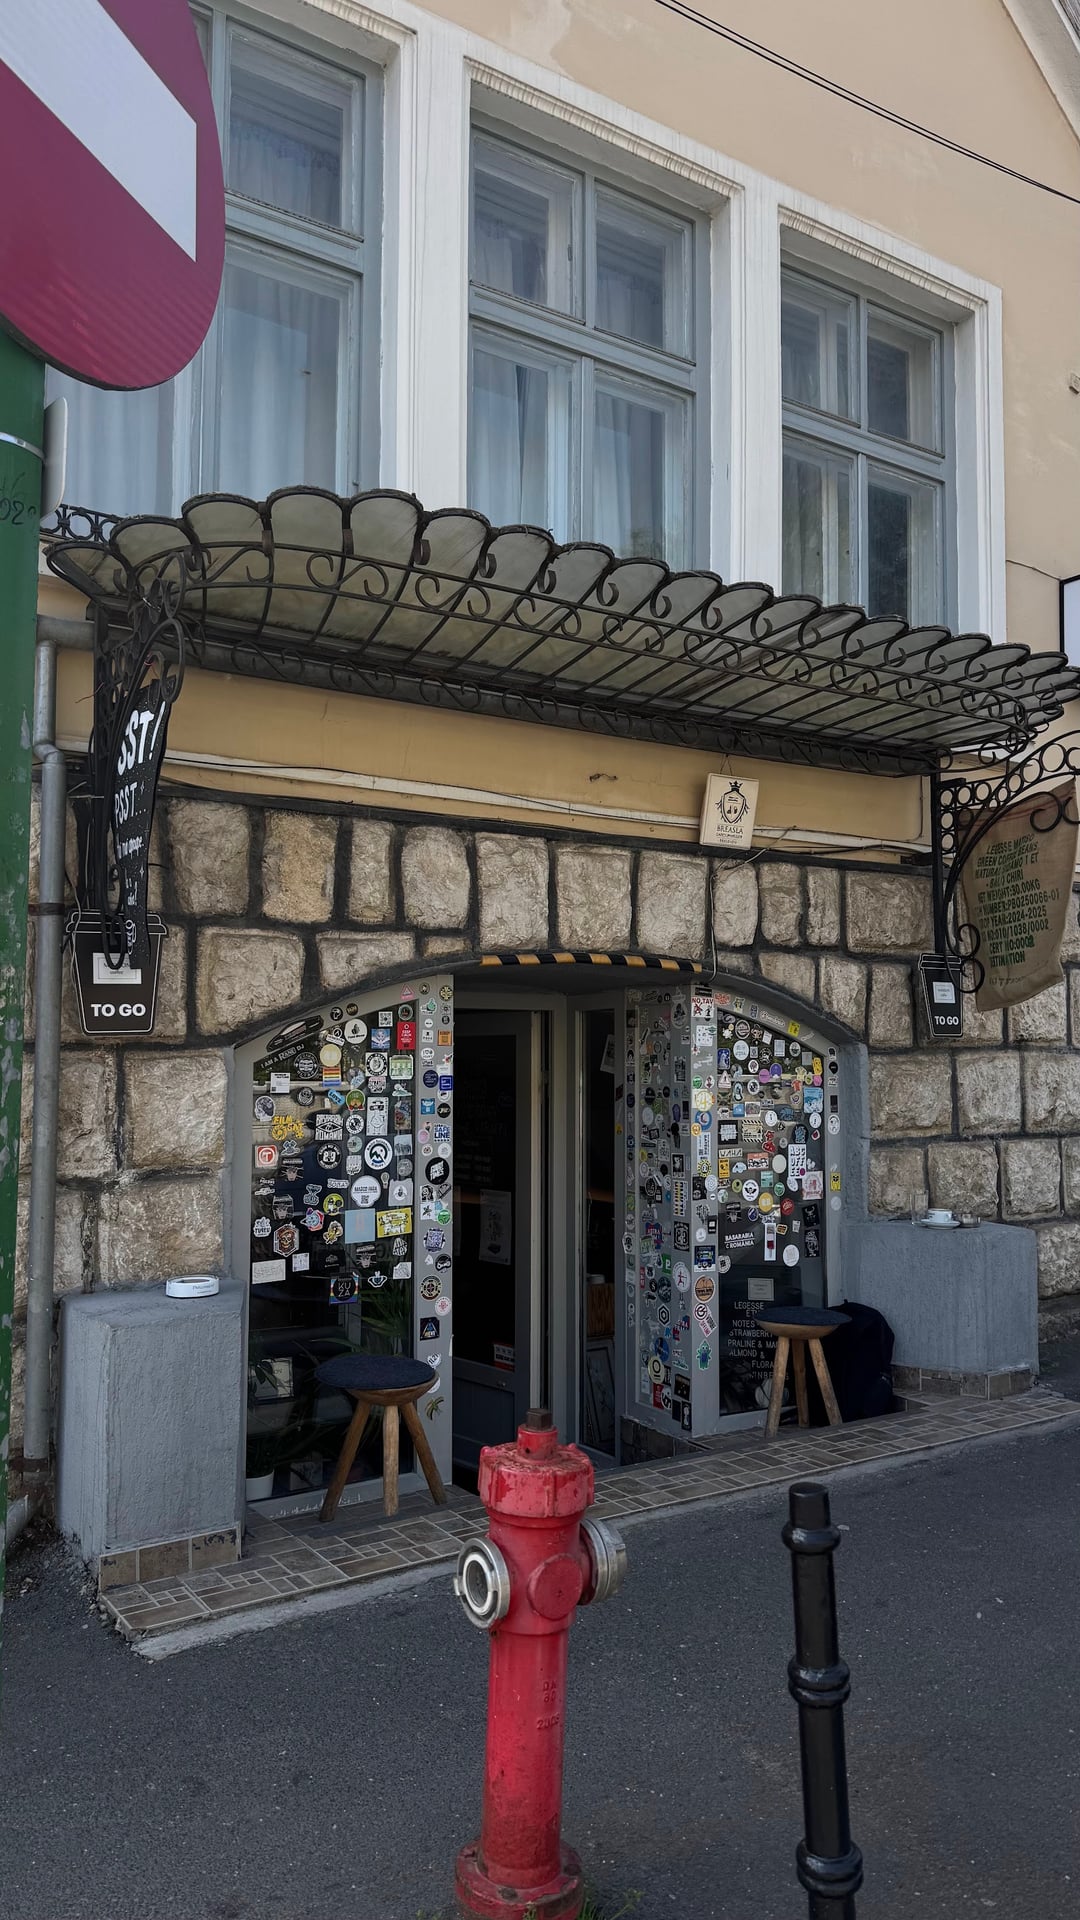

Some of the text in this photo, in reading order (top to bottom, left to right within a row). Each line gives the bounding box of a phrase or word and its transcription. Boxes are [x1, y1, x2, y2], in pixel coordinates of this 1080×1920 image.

[91, 1003, 146, 1017] TO GO
[934, 1015, 959, 1025] TO GO
[727, 1339, 757, 1348] PRALINE
